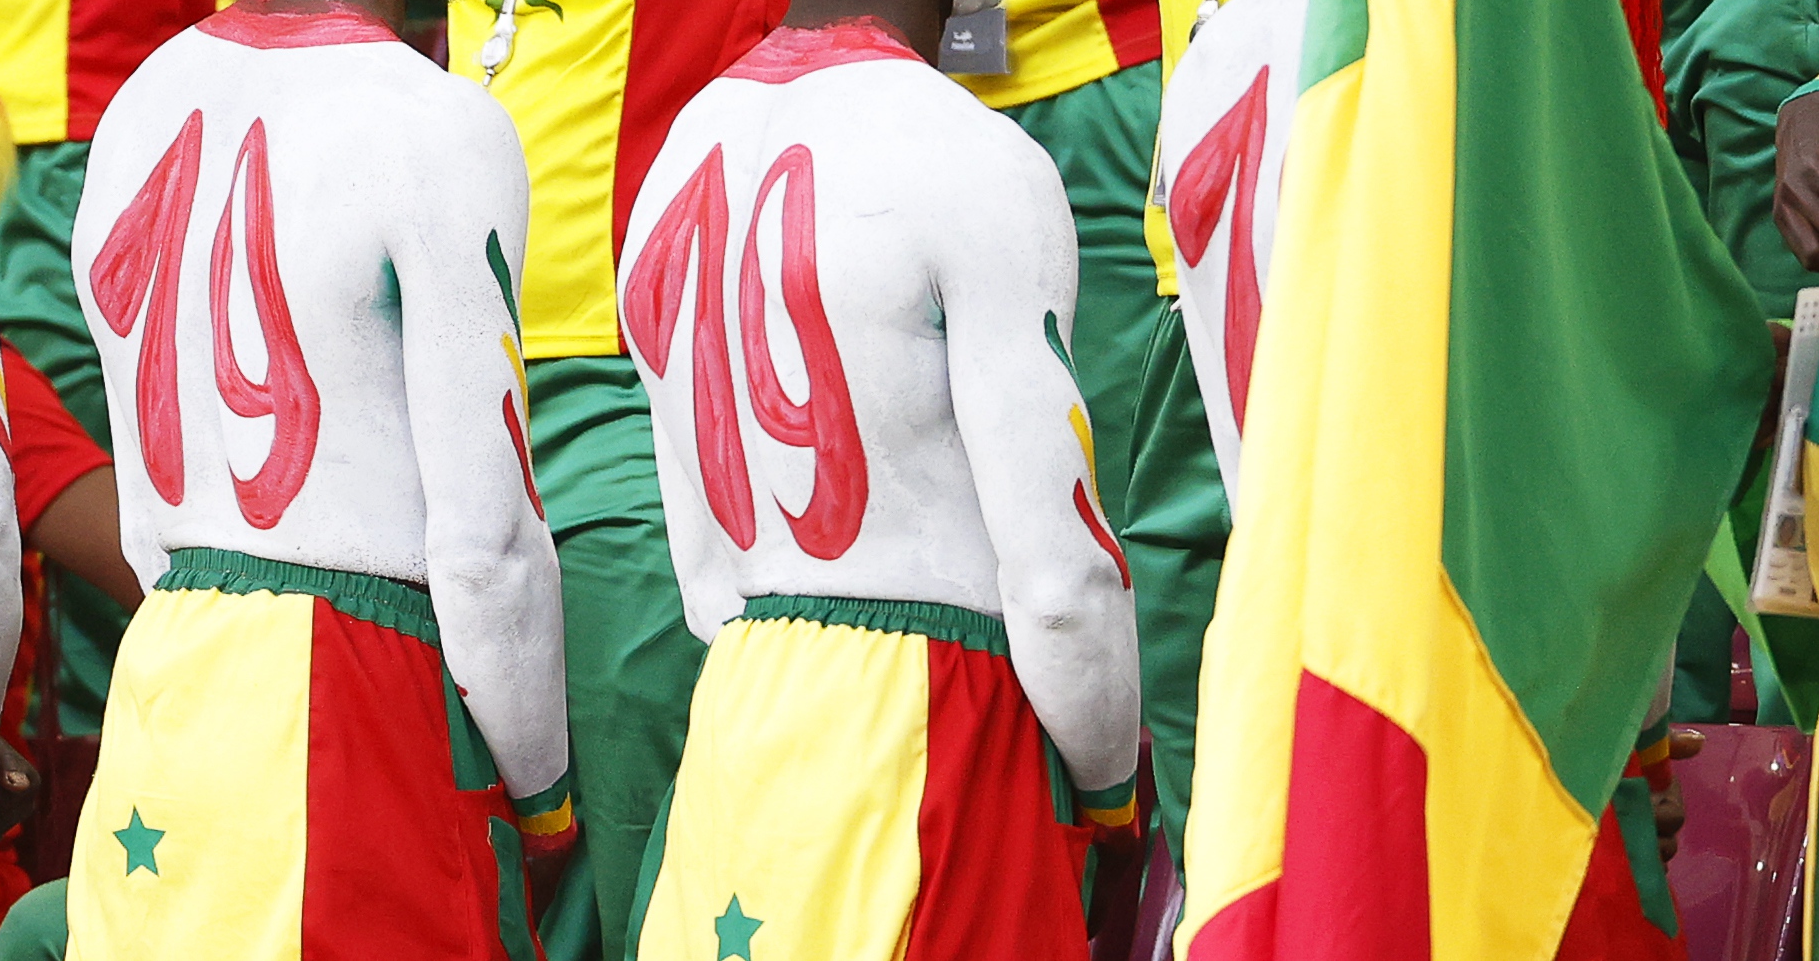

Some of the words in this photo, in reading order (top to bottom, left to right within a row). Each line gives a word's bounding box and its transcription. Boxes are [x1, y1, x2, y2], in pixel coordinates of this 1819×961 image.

[90, 109, 320, 529] 19
[624, 142, 868, 560] 19
[1169, 65, 1270, 441] 1
